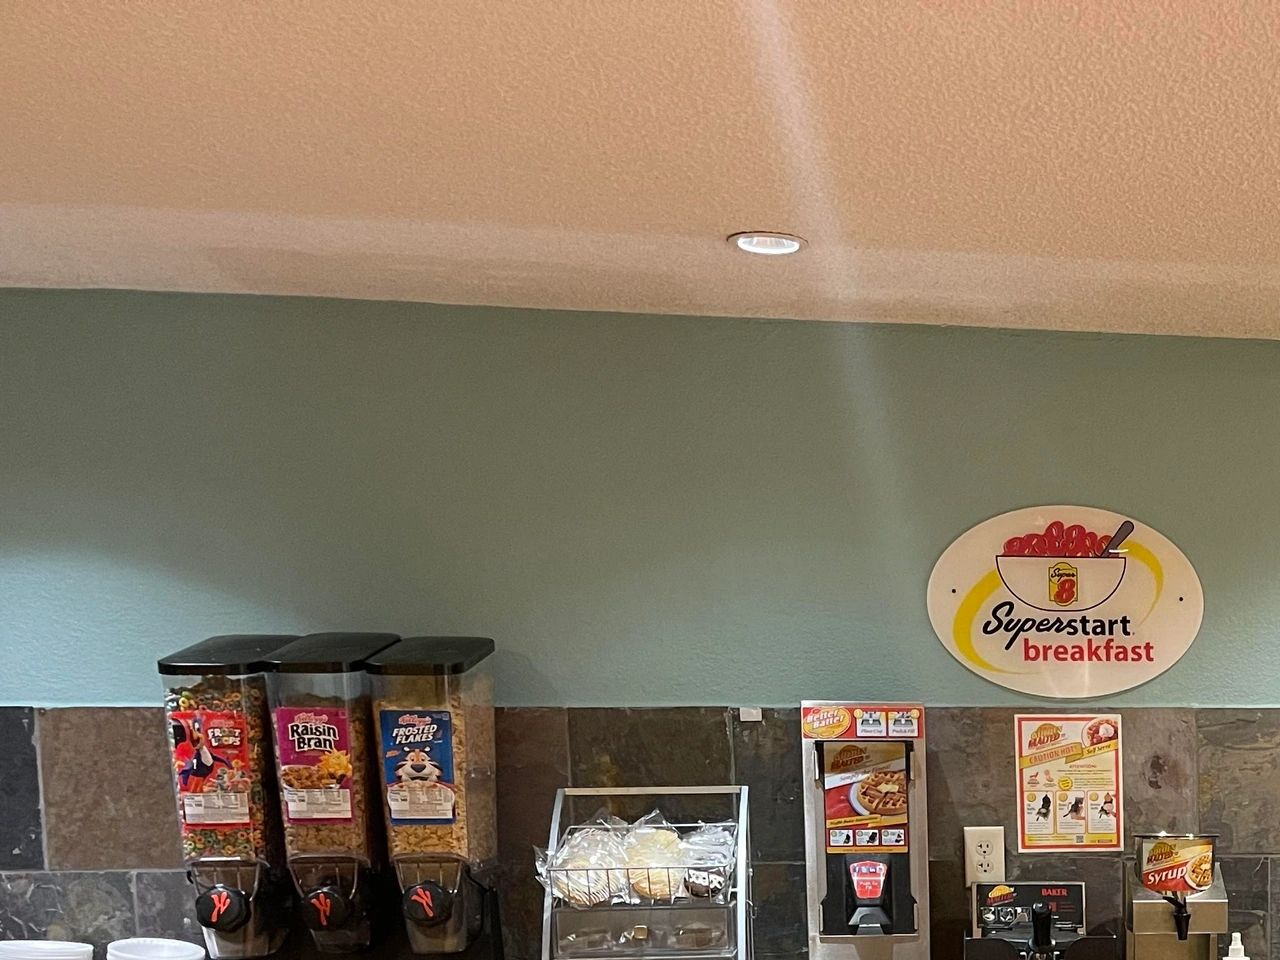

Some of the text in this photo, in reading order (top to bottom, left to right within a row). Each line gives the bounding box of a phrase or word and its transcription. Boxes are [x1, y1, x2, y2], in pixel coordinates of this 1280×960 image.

[1054, 578, 1076, 601] 8
[982, 601, 1131, 651] Superstart
[1023, 638, 1155, 663] breakfast
[290, 723, 338, 740] Raisin
[392, 724, 438, 737] FROSTED
[396, 733, 434, 745] FLAKES
[296, 737, 334, 750] Bran
[1148, 866, 1187, 885] Syrup
[1041, 888, 1068, 897] BAKER
